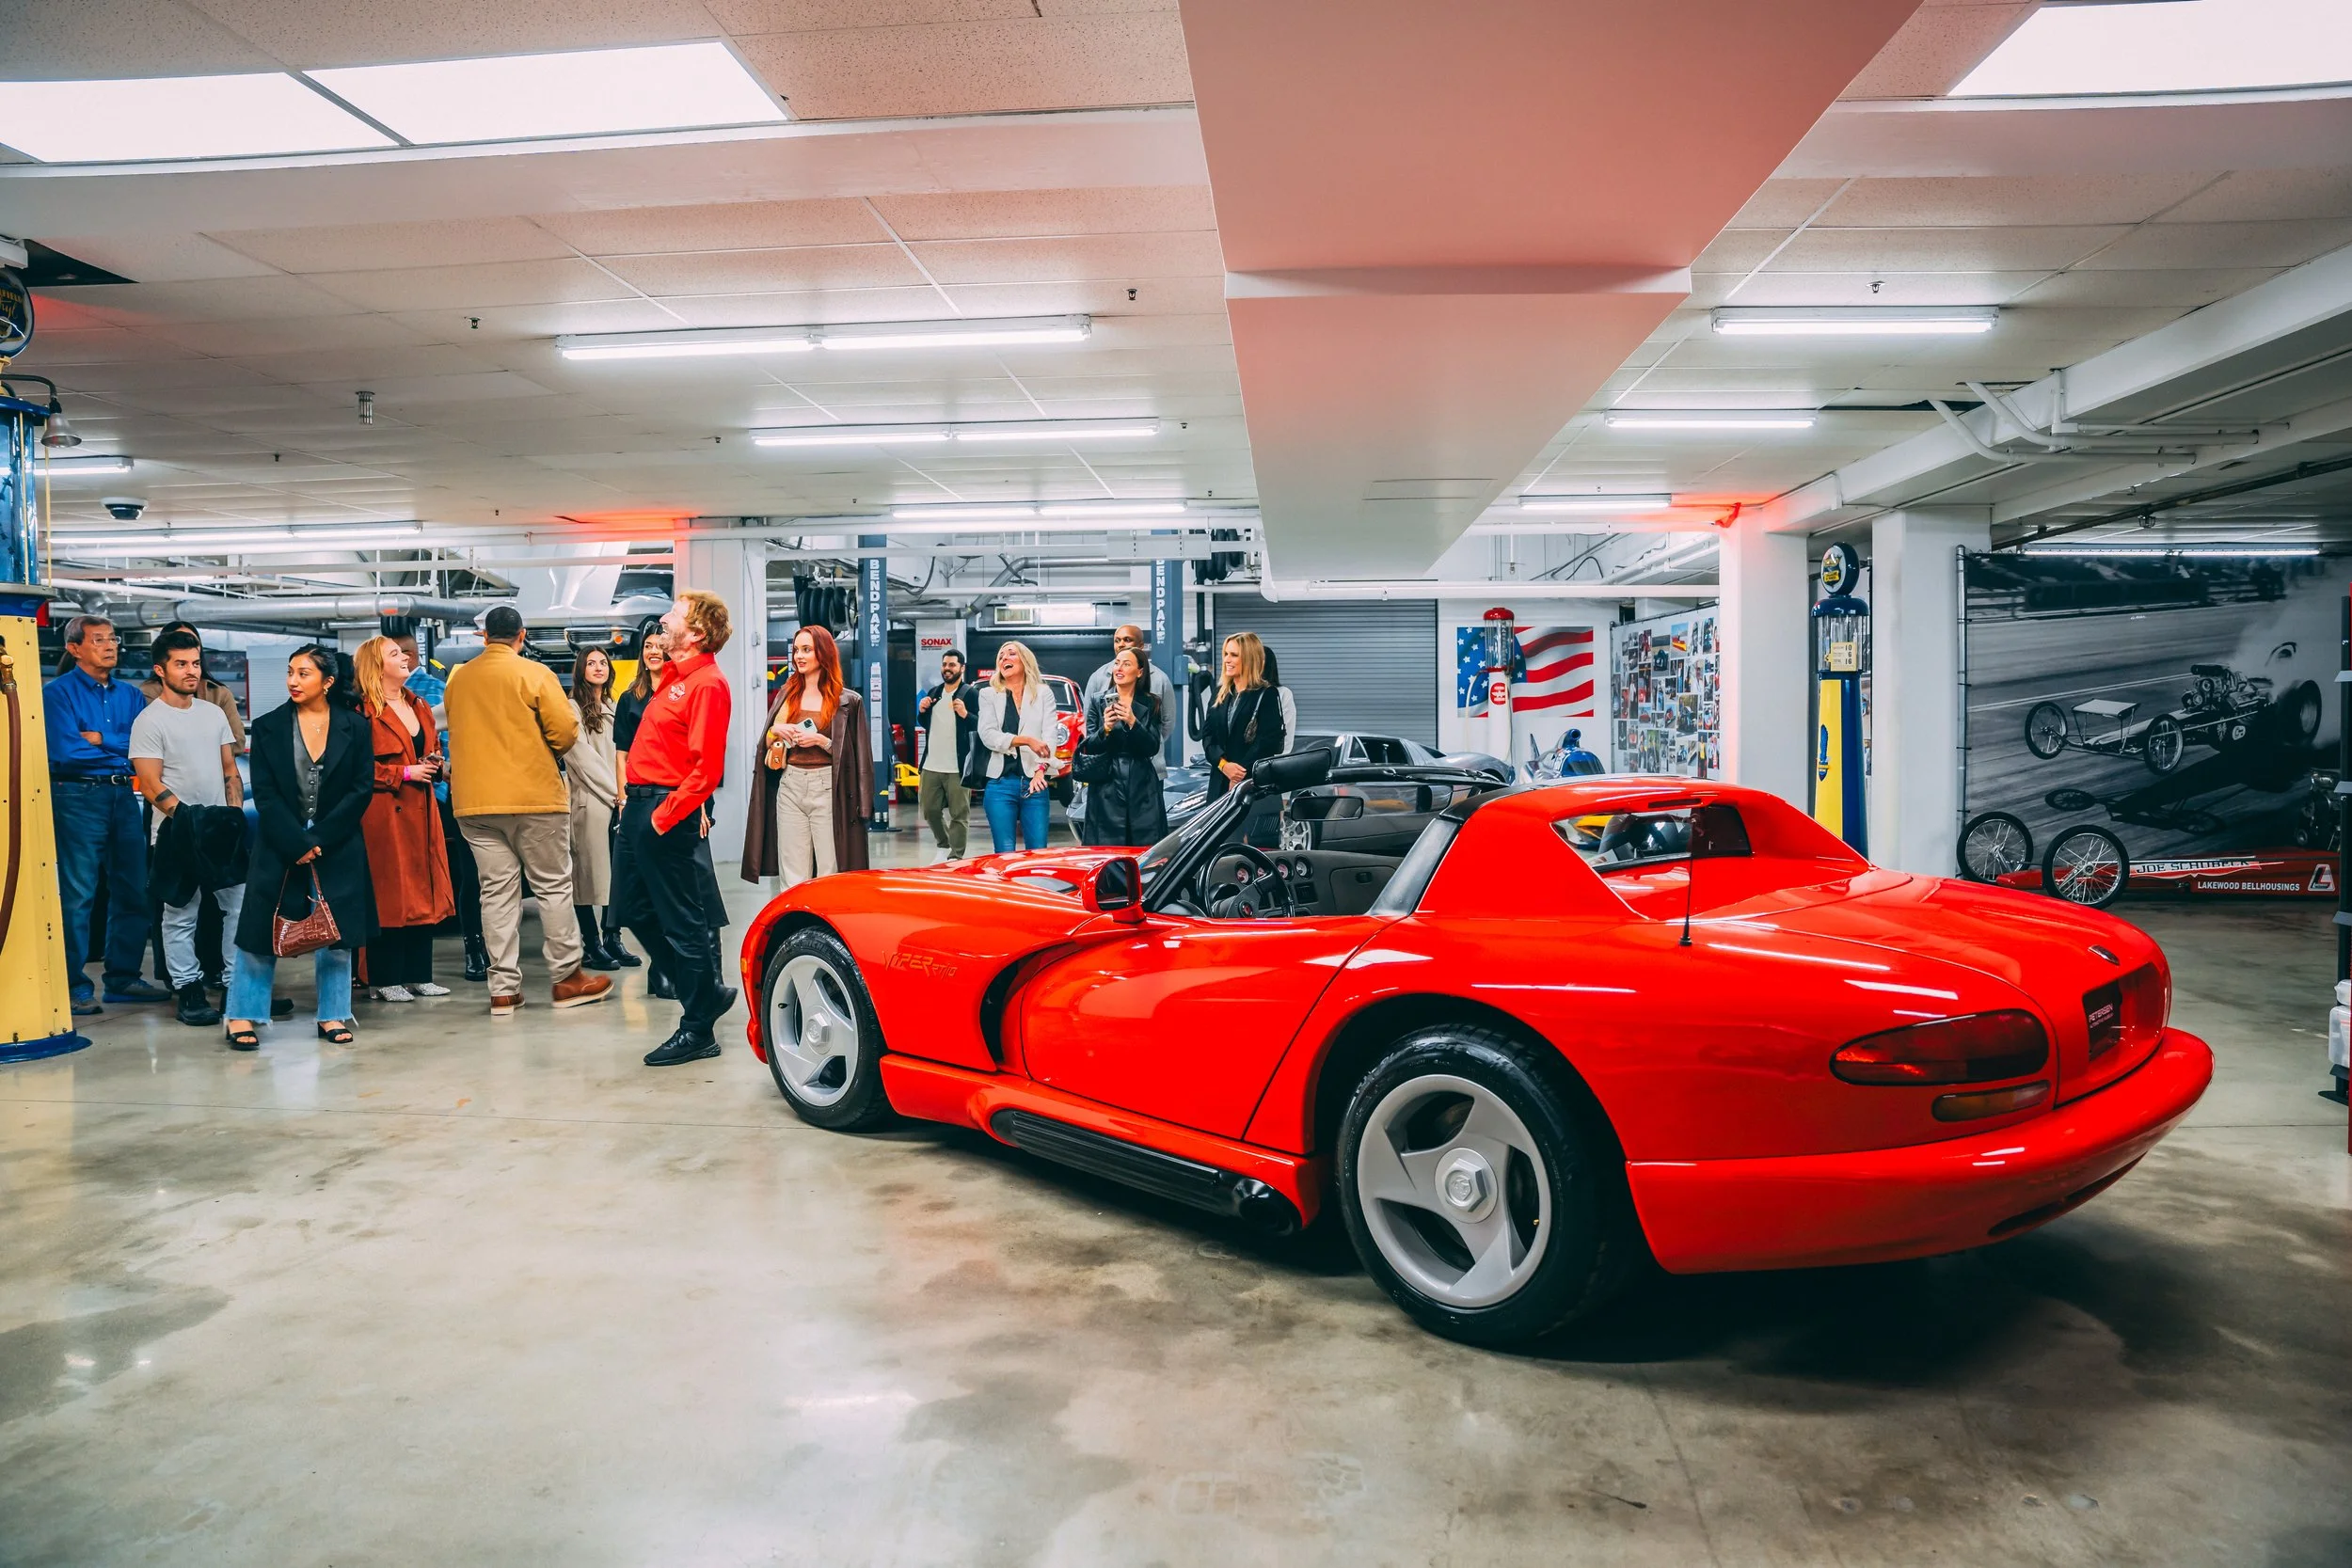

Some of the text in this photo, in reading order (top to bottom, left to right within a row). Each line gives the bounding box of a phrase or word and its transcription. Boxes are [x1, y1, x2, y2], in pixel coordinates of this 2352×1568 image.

[869, 559, 881, 634] BENDPAK
[920, 638, 952, 646] SONAX
[416, 632, 427, 673] BEN
[2137, 864, 2165, 874] JOE
[2198, 881, 2300, 892] LAKEWOOD BELLHOUSINGS
